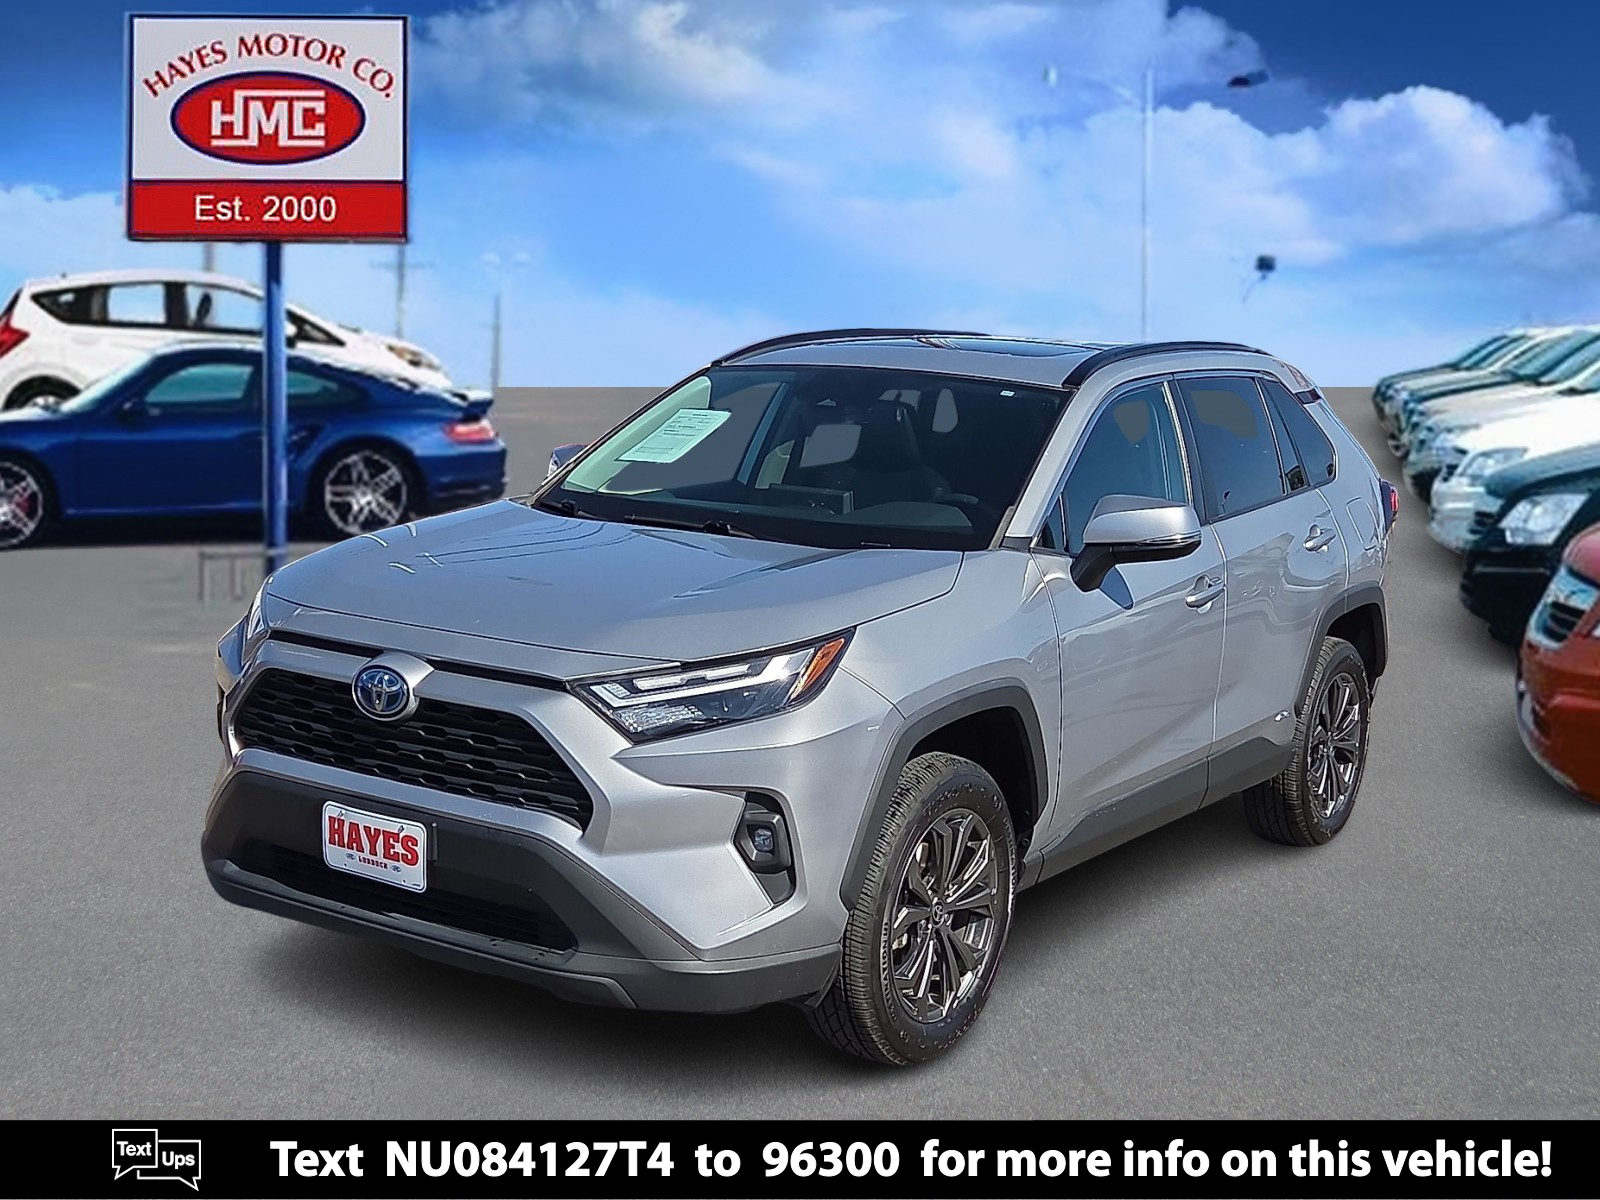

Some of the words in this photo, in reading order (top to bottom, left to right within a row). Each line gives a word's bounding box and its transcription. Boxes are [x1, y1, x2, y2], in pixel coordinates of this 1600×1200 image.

[142, 40, 228, 98] HAYES
[237, 33, 347, 69] MOTOR
[352, 57, 395, 98] CO.
[210, 89, 326, 147] HMC
[194, 195, 250, 222] Est.
[262, 195, 337, 222] 2000
[328, 815, 419, 867] HAYES
